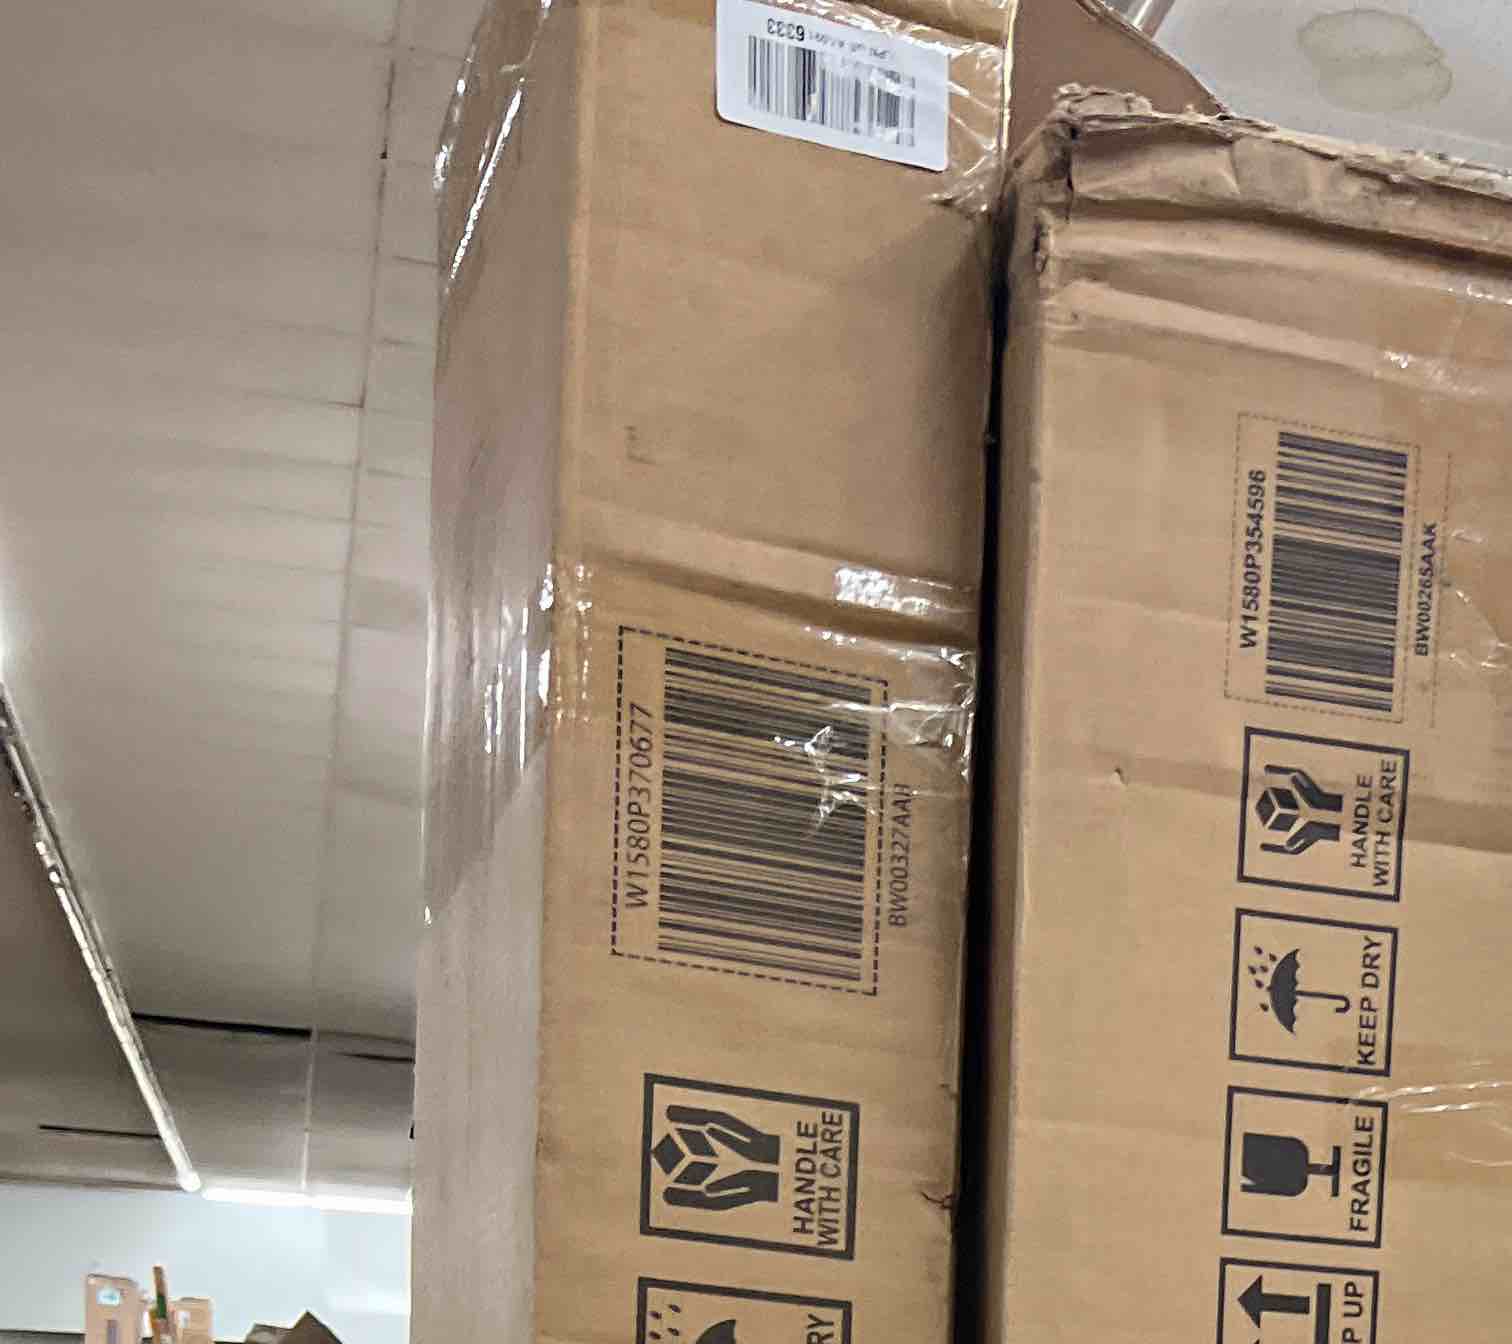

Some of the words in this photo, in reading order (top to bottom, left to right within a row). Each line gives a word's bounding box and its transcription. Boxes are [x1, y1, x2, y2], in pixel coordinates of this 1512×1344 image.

[1239, 469, 1266, 649] W1580P354596
[625, 702, 654, 911] W1580P370677
[1350, 774, 1373, 868] HANDLE
[1378, 759, 1397, 824] CARE
[1372, 828, 1391, 887] WITH
[1362, 935, 1382, 990] DRY
[1357, 997, 1378, 1066] KEEP
[792, 1121, 818, 1234] HANDLE
[820, 1111, 843, 1183] CARE
[1349, 1116, 1375, 1232] FRAGILE
[818, 1187, 840, 1248] WITH
[1343, 1281, 1364, 1318] UP
